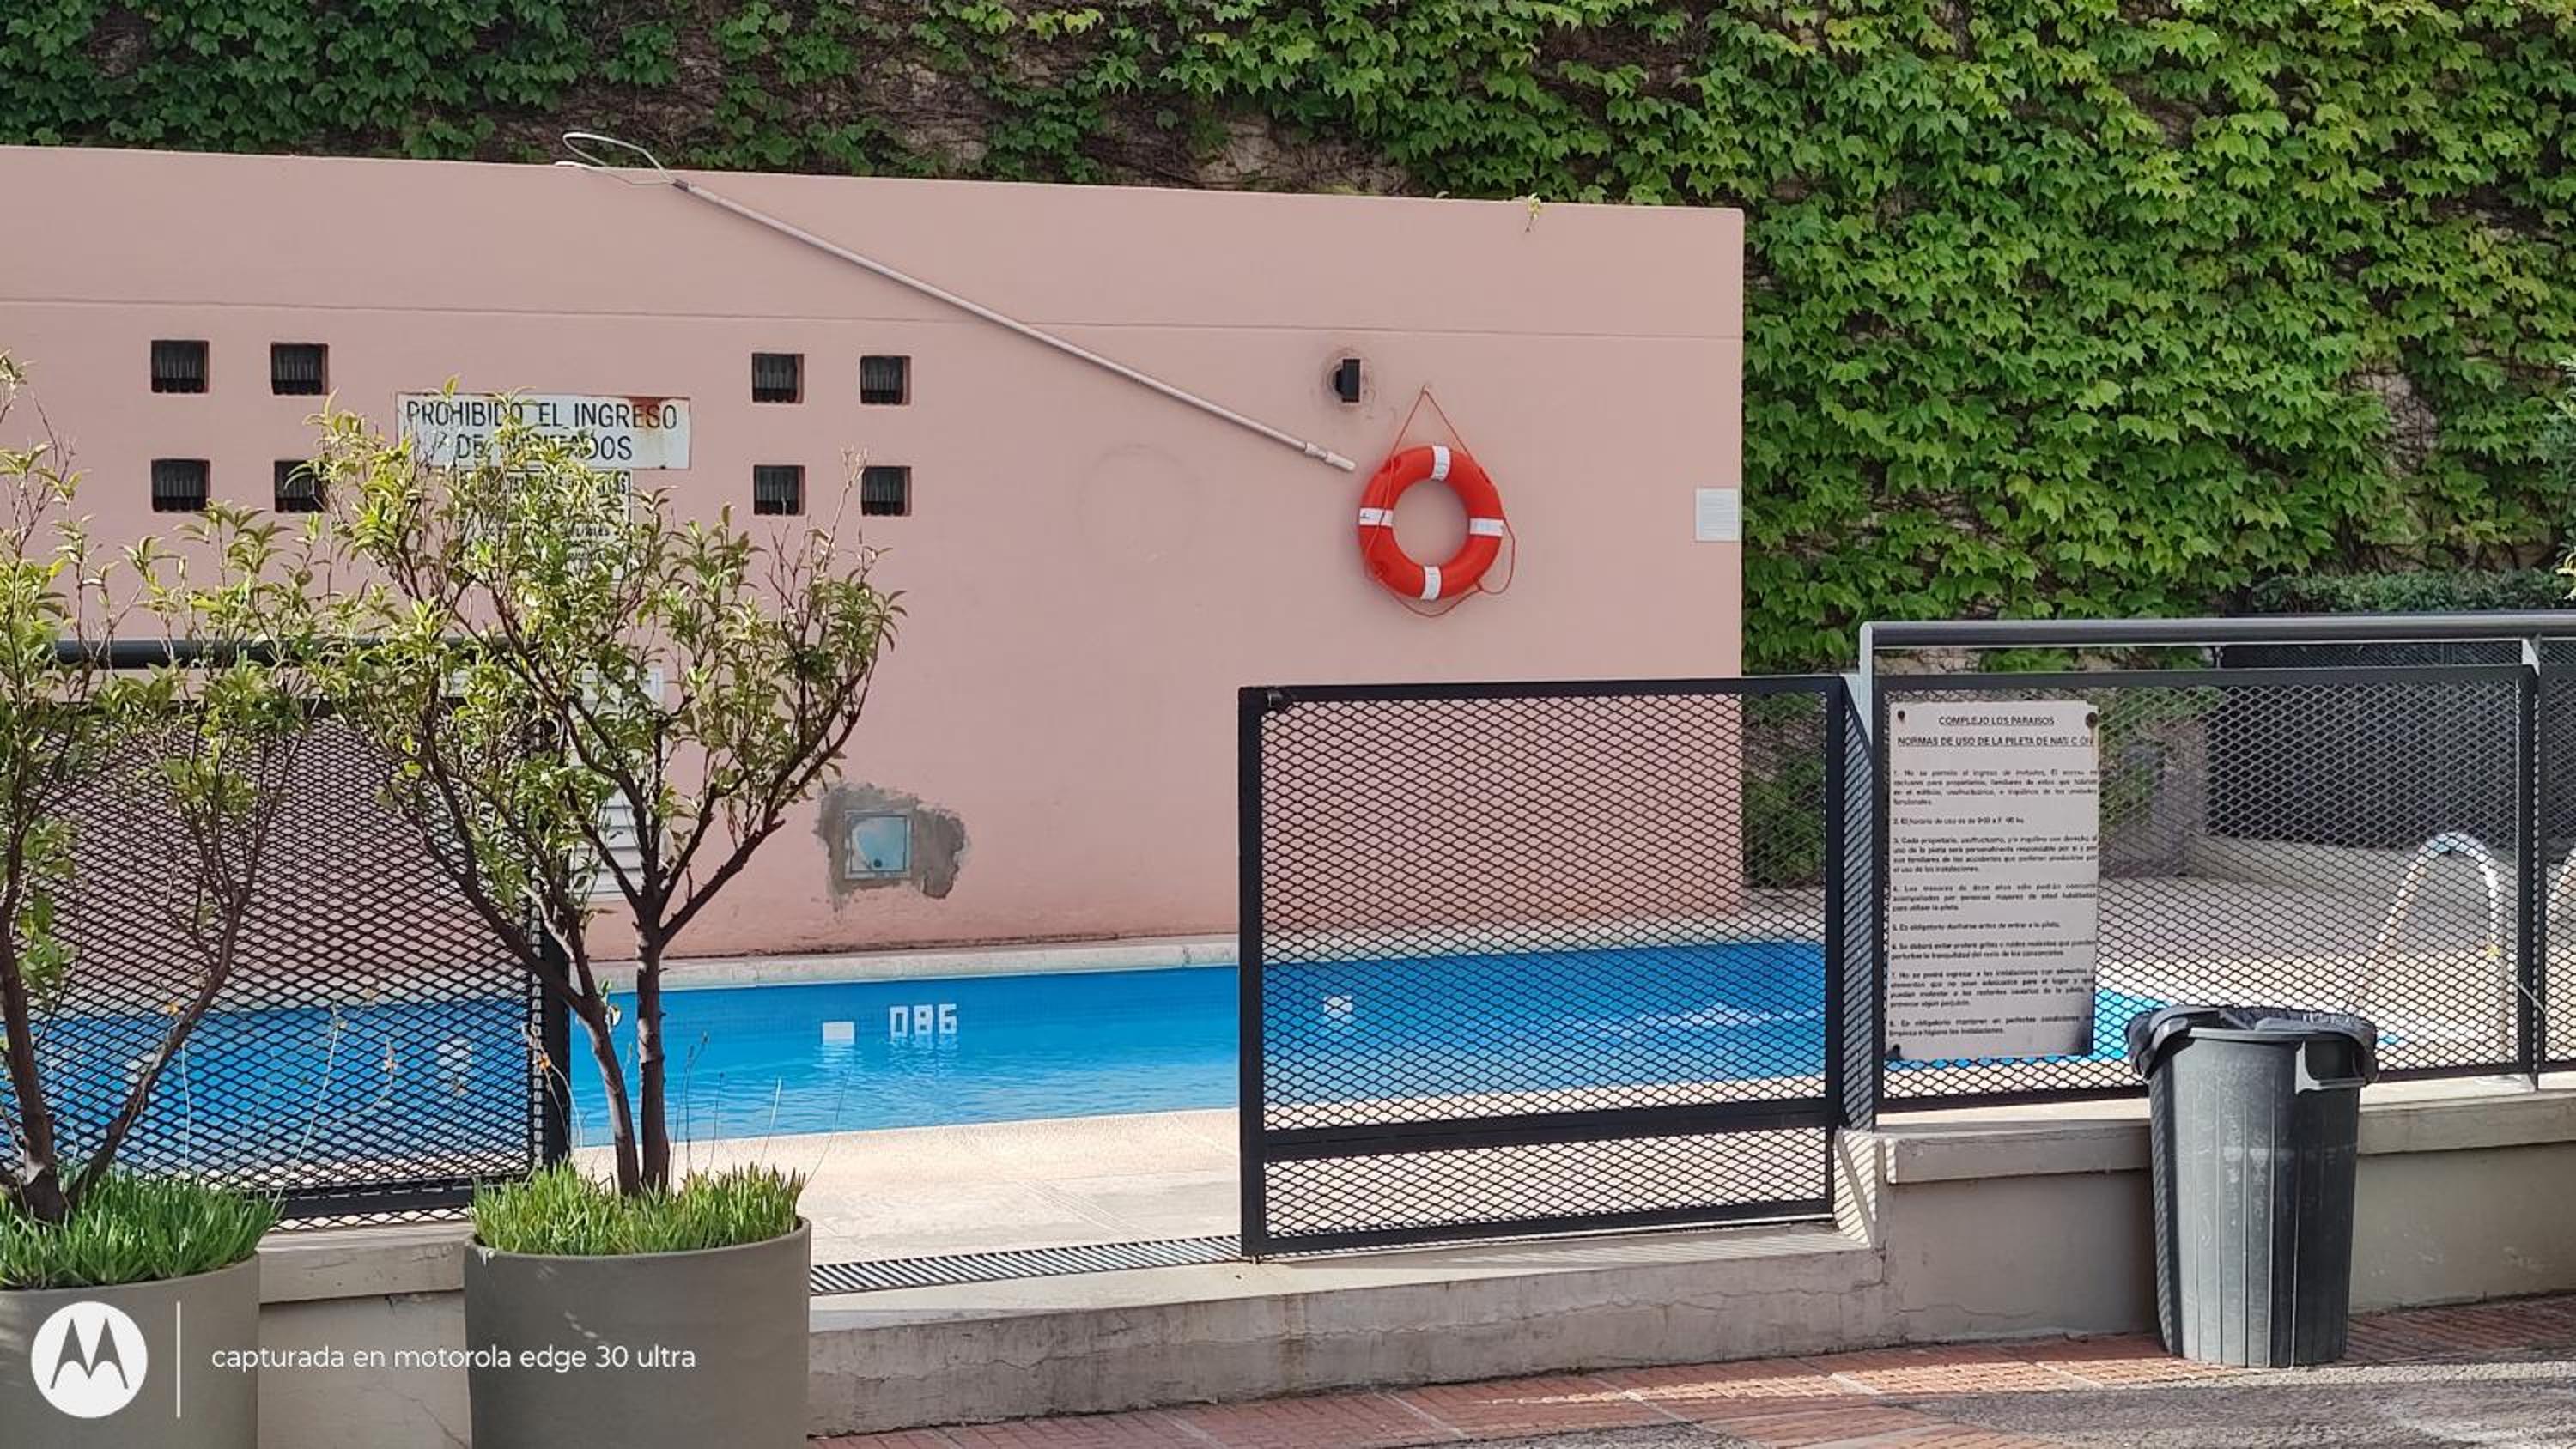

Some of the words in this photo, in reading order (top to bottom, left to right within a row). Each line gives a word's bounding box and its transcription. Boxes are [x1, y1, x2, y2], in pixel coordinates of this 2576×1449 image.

[407, 401, 523, 427] PROHIBIDO
[538, 401, 564, 428] EL
[574, 402, 677, 430] INGRESO
[456, 434, 486, 459] DE
[1938, 716, 1989, 724] COMPLEJO
[1991, 716, 2009, 724] LOS
[1897, 736, 1936, 745] NORMAS
[1939, 736, 1953, 746] DE
[1955, 736, 1975, 746] USO
[1978, 736, 1989, 746] DE
[1991, 736, 2002, 745] LA
[2005, 736, 2033, 745] PILETA
[2036, 735, 2048, 745] DE
